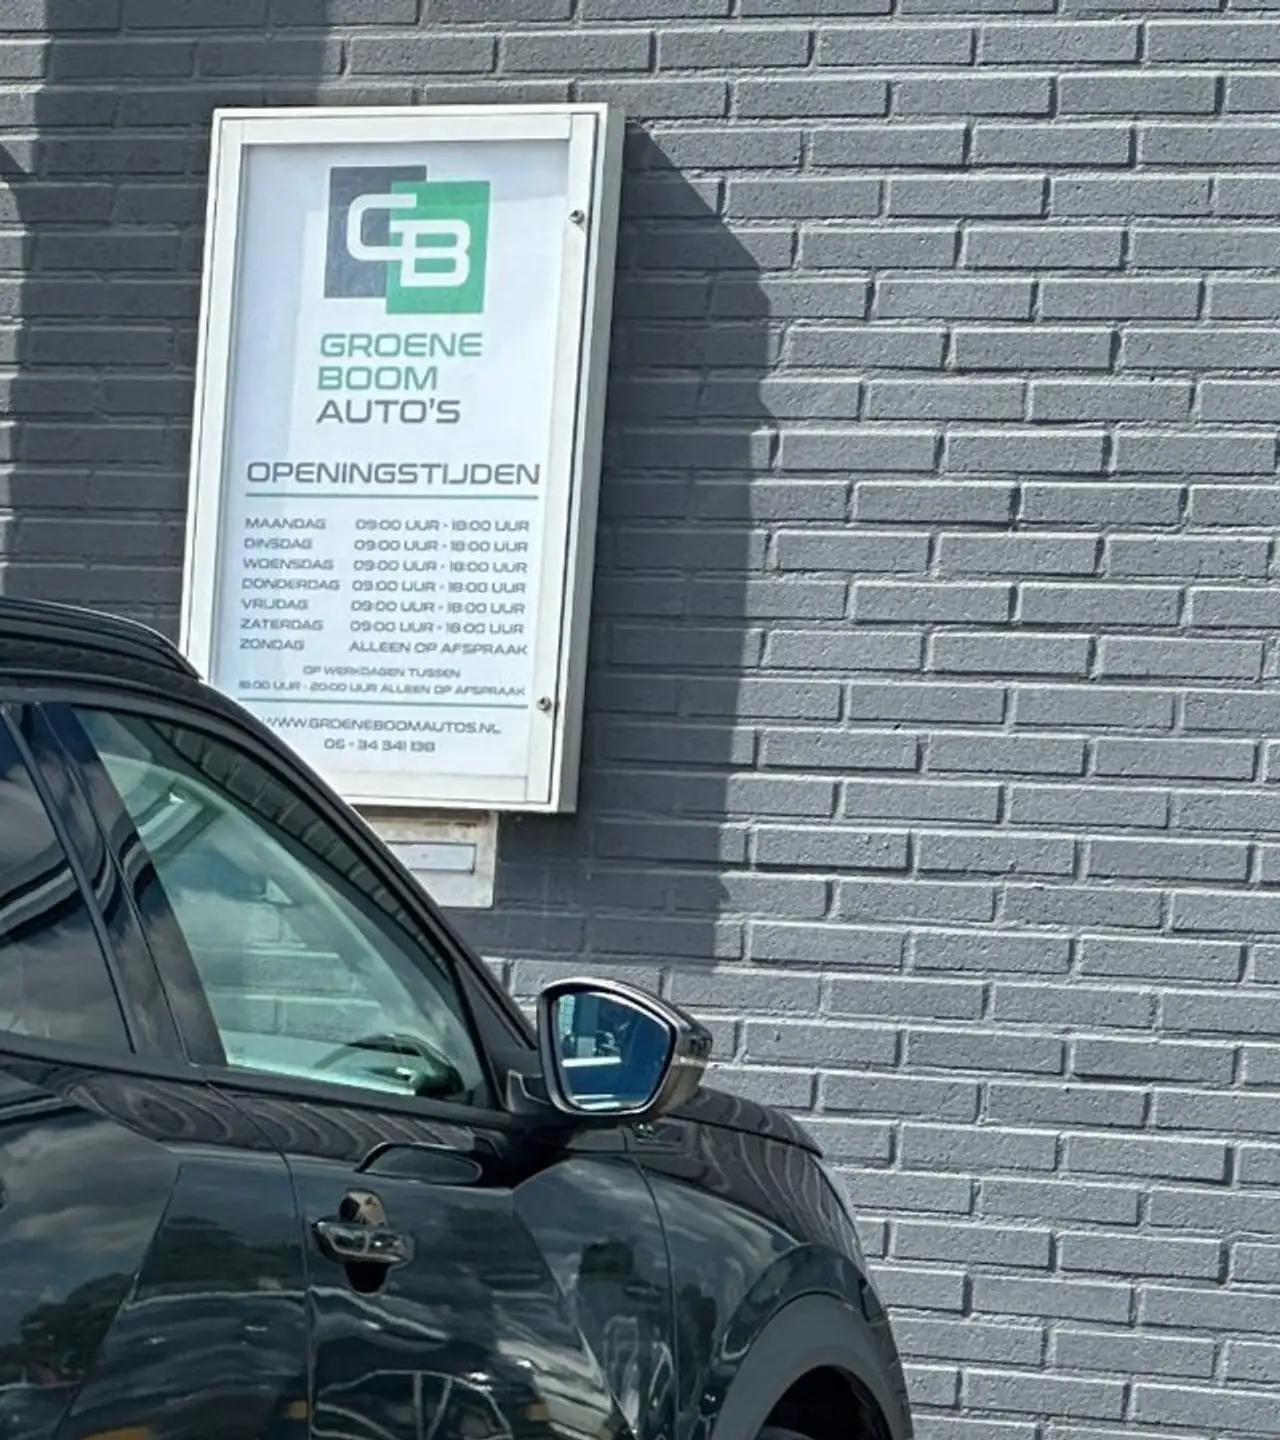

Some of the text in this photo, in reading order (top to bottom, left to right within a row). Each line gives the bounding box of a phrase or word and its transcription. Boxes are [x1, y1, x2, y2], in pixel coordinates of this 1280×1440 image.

[319, 332, 483, 358] GROENE
[316, 365, 438, 391] BOOM
[315, 397, 461, 424] AUTO'S
[246, 461, 540, 486] OPENINGSTIJDEN
[245, 518, 327, 530] MAANDAG
[405, 519, 440, 531] UUR
[494, 520, 530, 532] UUR
[244, 538, 313, 550] DINSDAG
[403, 540, 439, 552] UUR
[493, 541, 529, 553] UUR
[242, 558, 334, 570] WOENSDAG
[402, 560, 438, 572] UUR
[492, 561, 528, 574] UUR
[241, 578, 340, 591] DONDERDAG
[401, 580, 436, 593] UUR
[491, 582, 526, 594] UUR
[241, 598, 309, 610] VRIJDAG
[400, 601, 435, 613] UUR
[490, 602, 525, 615] UUR
[240, 619, 324, 631] ZATERDAG
[399, 621, 434, 633] UUR
[489, 623, 524, 635] UUR
[239, 638, 529, 656] ZONDAG ALLEEN OP AFSPRAAK
[302, 665, 461, 679] OP WERKDAGEN TUSSEN
[273, 681, 301, 692] UUR
[349, 682, 378, 694] UUR
[381, 682, 432, 695] ALLEEN
[454, 684, 526, 697] AFSPRAAK
[323, 738, 346, 751] 06
